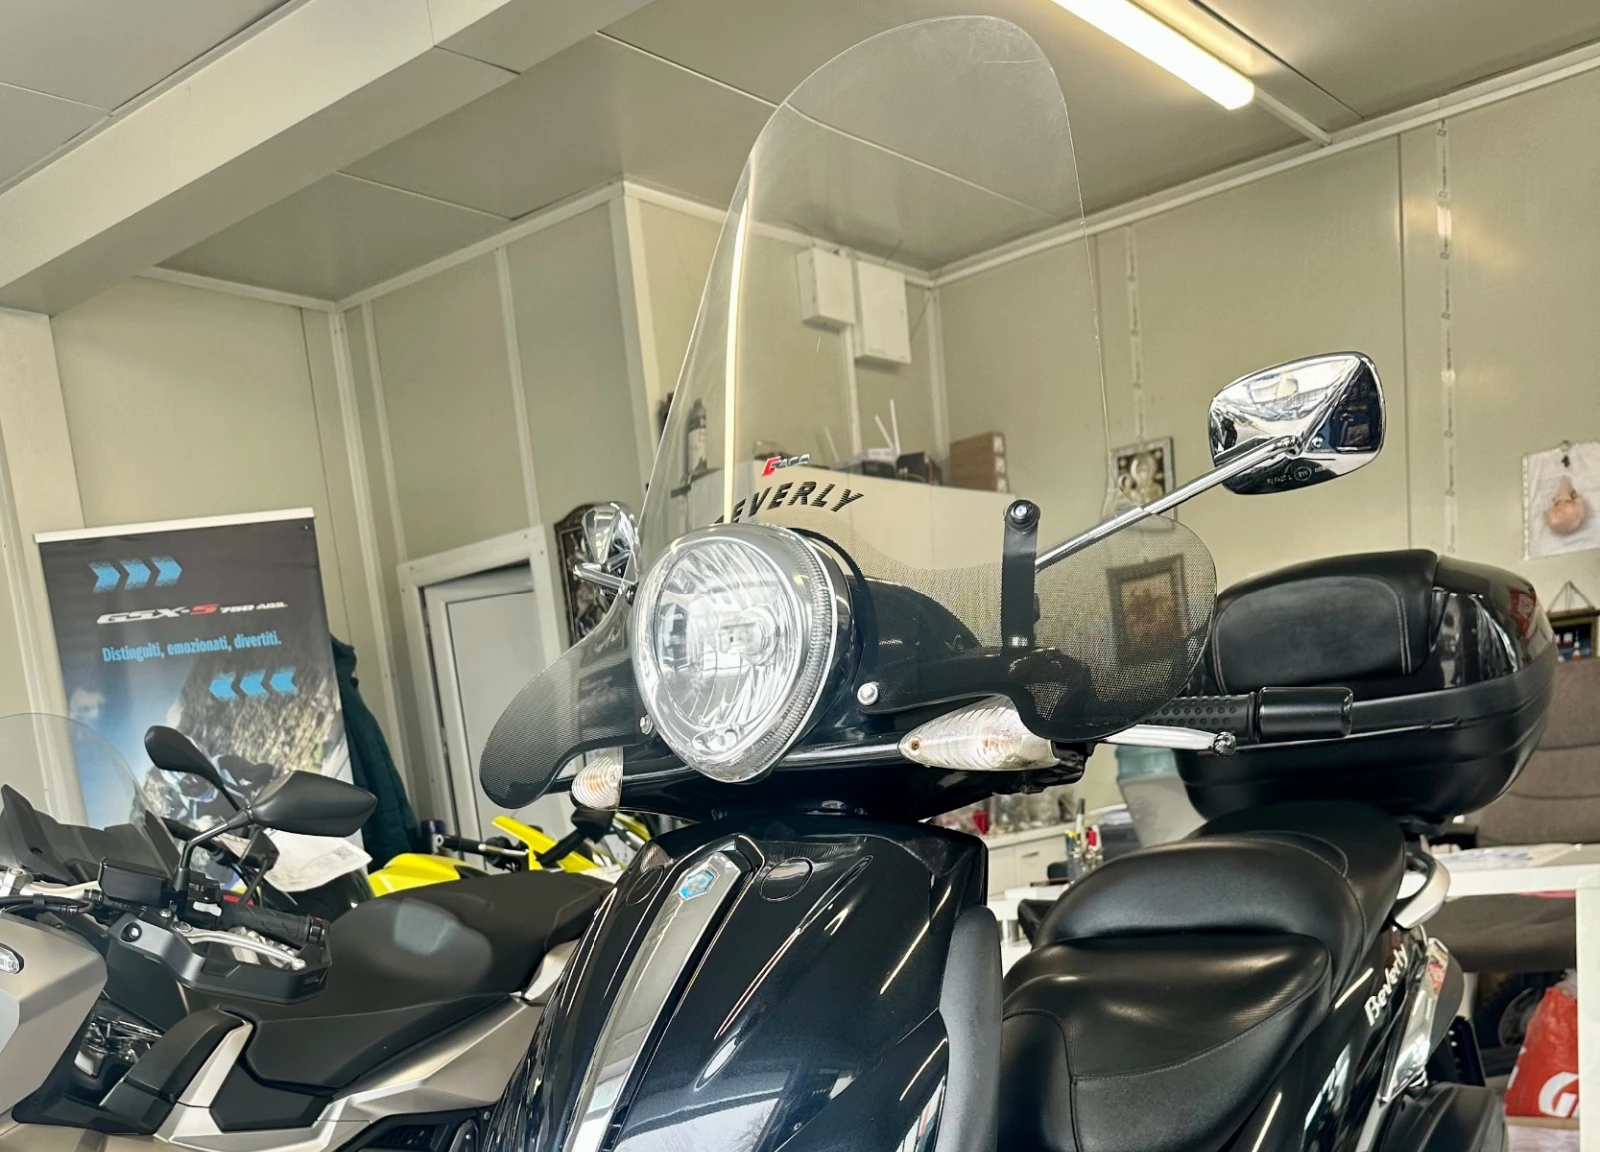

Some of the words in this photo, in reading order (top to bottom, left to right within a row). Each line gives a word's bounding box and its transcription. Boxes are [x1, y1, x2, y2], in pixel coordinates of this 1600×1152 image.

[714, 480, 865, 524] EVERLY
[97, 603, 219, 624] GSX-S
[102, 641, 165, 662] Distinguiti,
[167, 635, 232, 656] emozionati,
[234, 630, 282, 649] divertiti.
[1364, 943, 1408, 1026] Beverly
